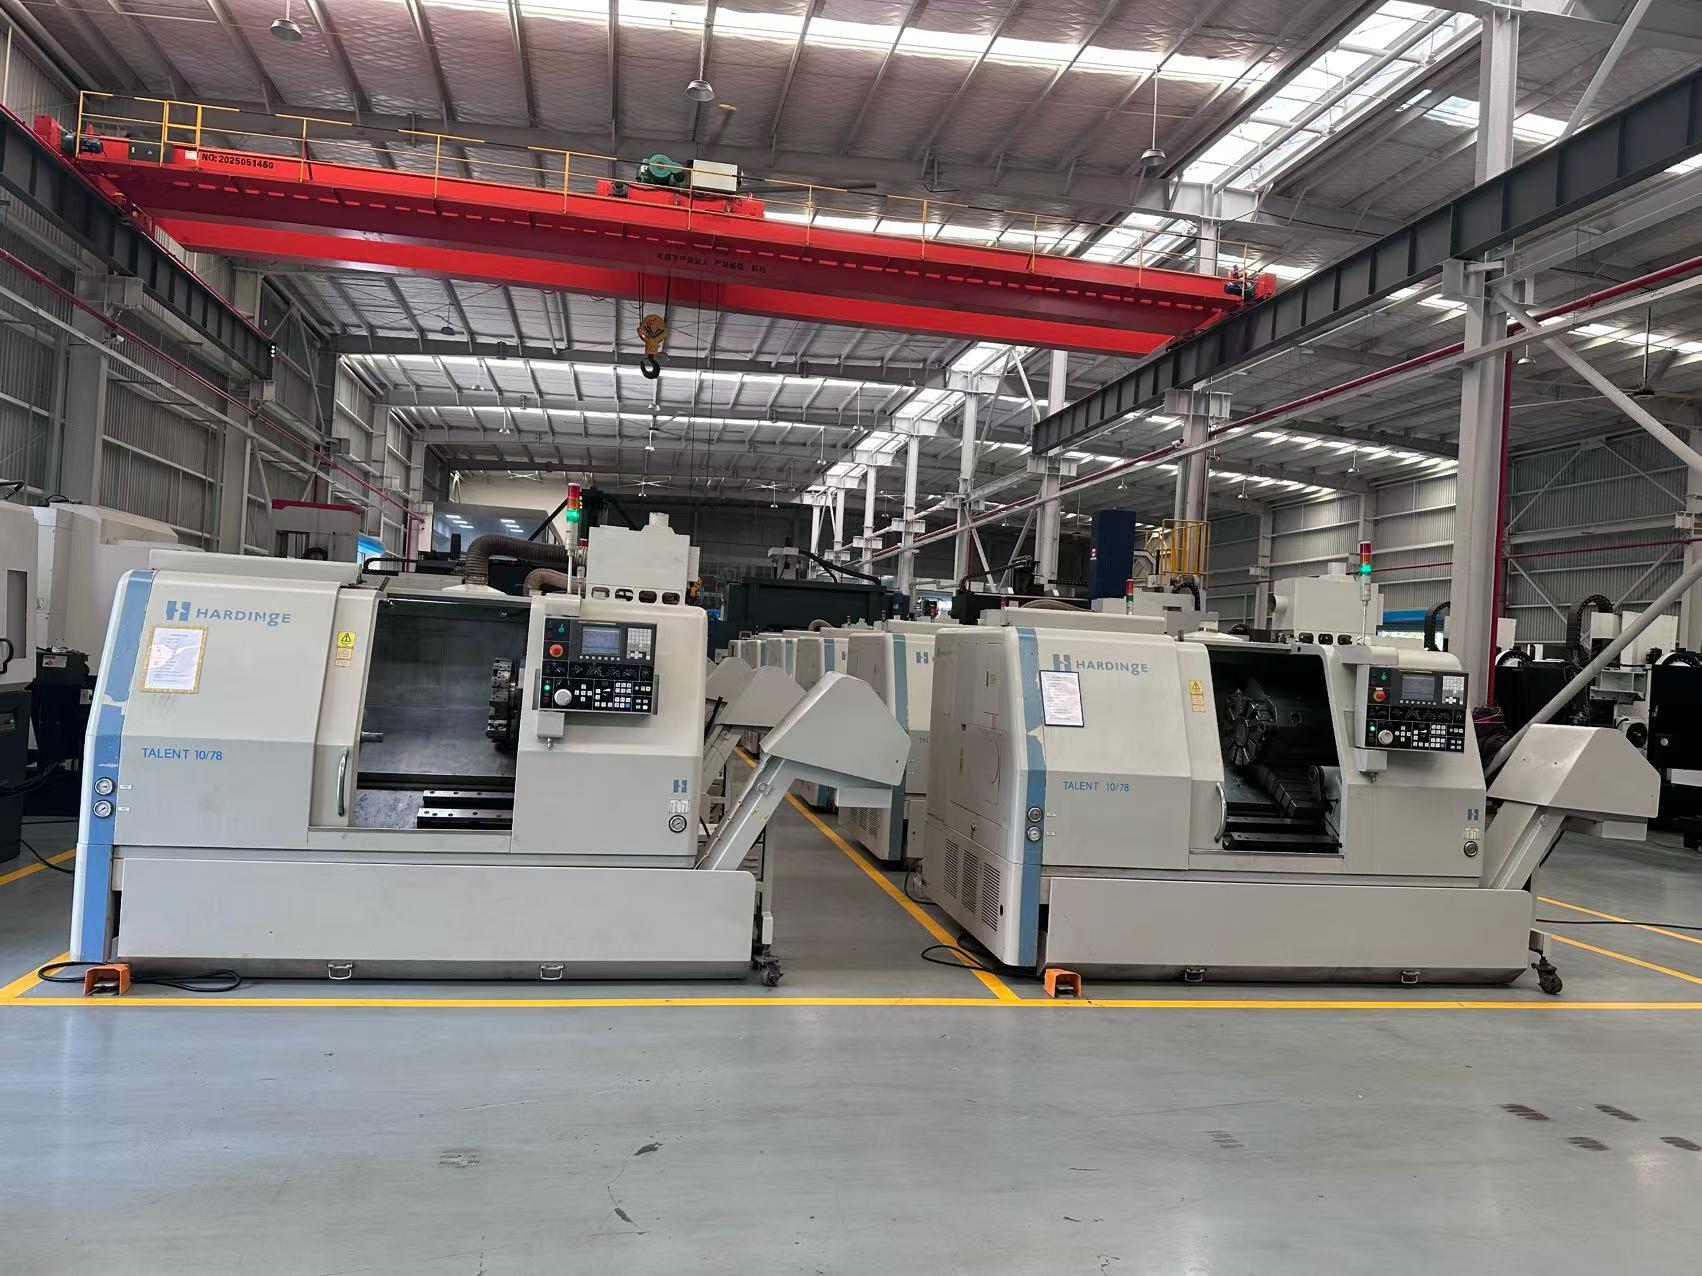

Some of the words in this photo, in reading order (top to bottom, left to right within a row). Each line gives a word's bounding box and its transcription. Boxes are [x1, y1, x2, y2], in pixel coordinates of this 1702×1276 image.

[141, 747, 190, 760] TALENT
[194, 750, 223, 761] 10/78
[1063, 781, 1099, 791] TALENT
[1106, 782, 1130, 792] 10/78
